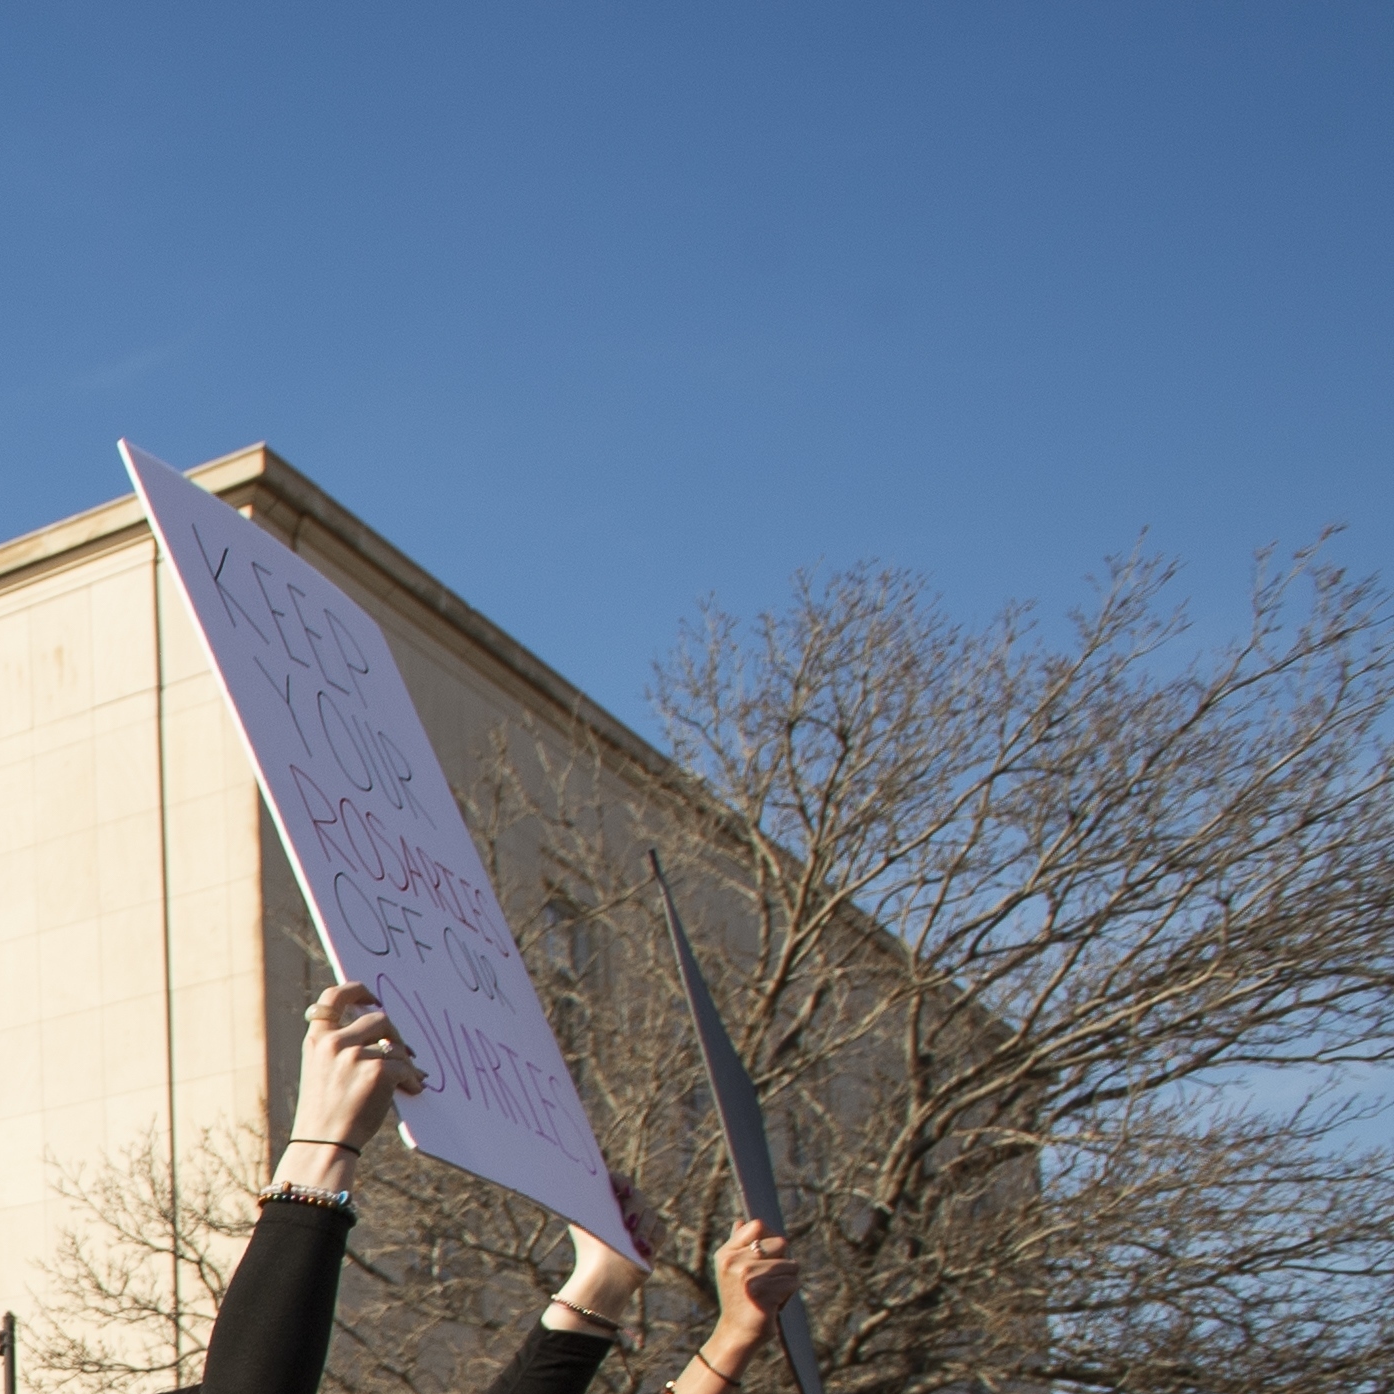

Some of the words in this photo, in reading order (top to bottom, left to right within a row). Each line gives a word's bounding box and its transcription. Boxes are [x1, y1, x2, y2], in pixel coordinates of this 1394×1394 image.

[191, 522, 370, 709] KEEP
[252, 655, 438, 831] YOUR
[289, 763, 510, 959] ROSARIES
[334, 871, 433, 964] OFF
[443, 927, 516, 1015] OUR
